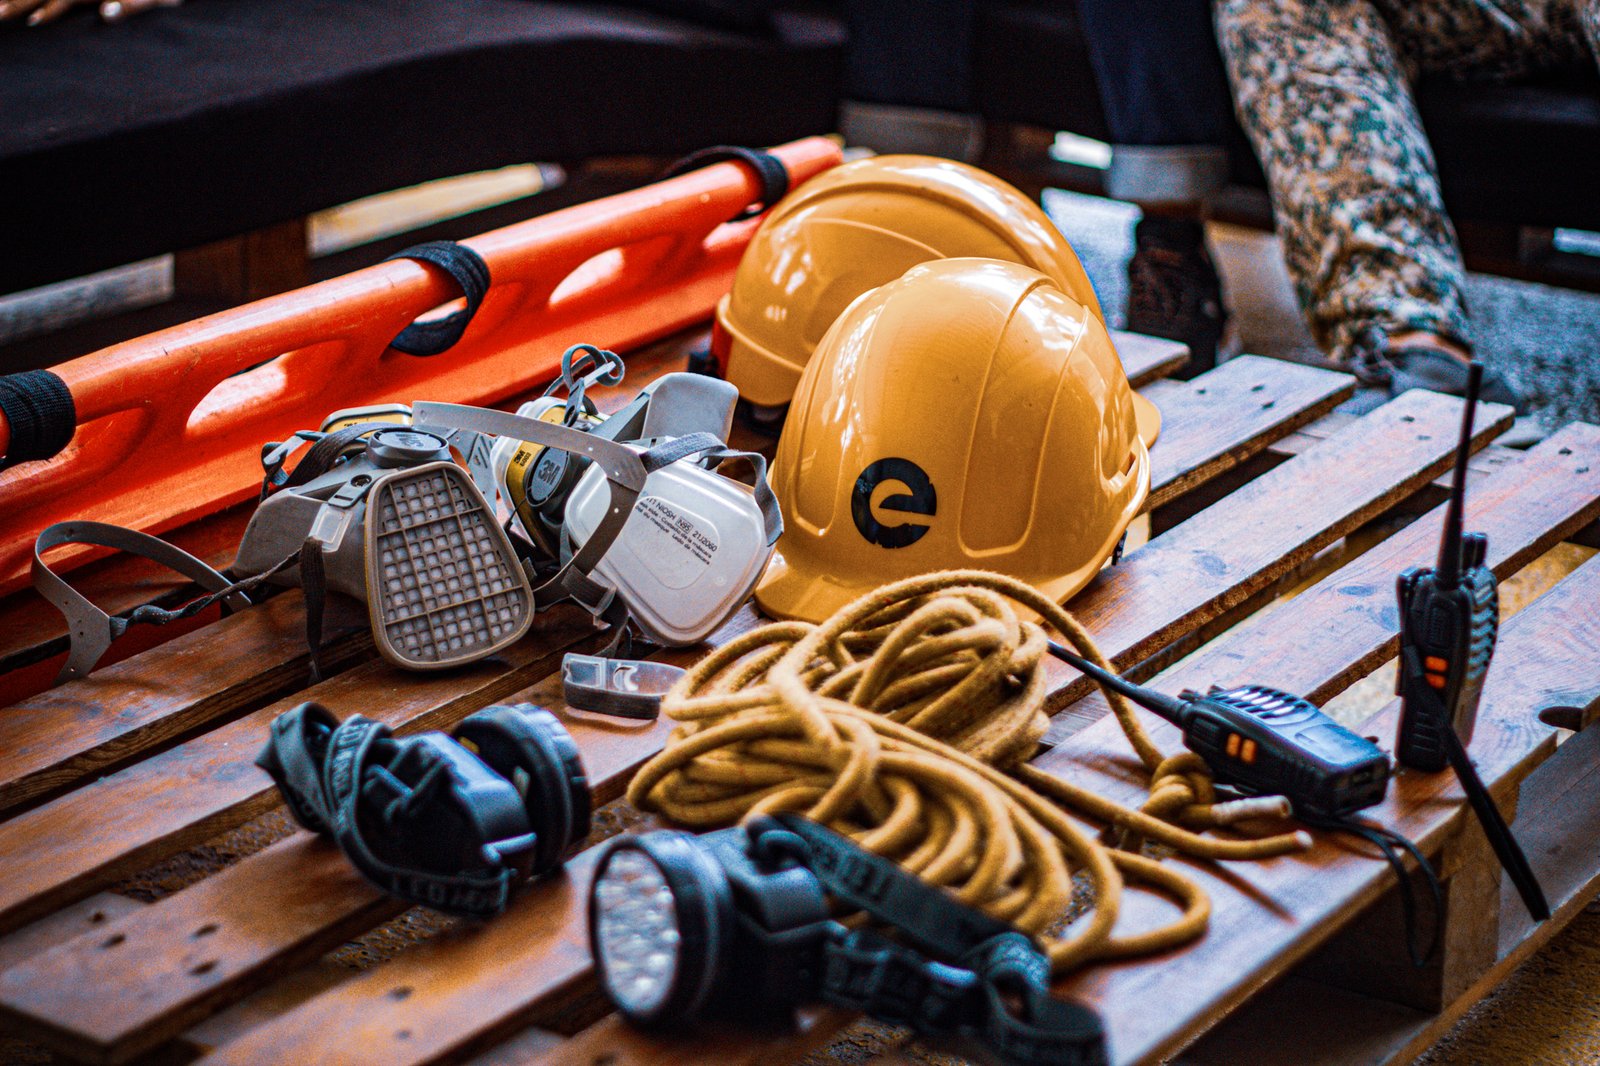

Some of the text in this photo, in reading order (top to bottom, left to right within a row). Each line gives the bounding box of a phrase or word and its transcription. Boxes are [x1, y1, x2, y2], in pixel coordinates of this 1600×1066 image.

[514, 450, 526, 464] 3M
[538, 459, 561, 485] 3M
[650, 517, 670, 534] masque
[656, 503, 676, 520] NIOSH
[678, 519, 691, 532] N95
